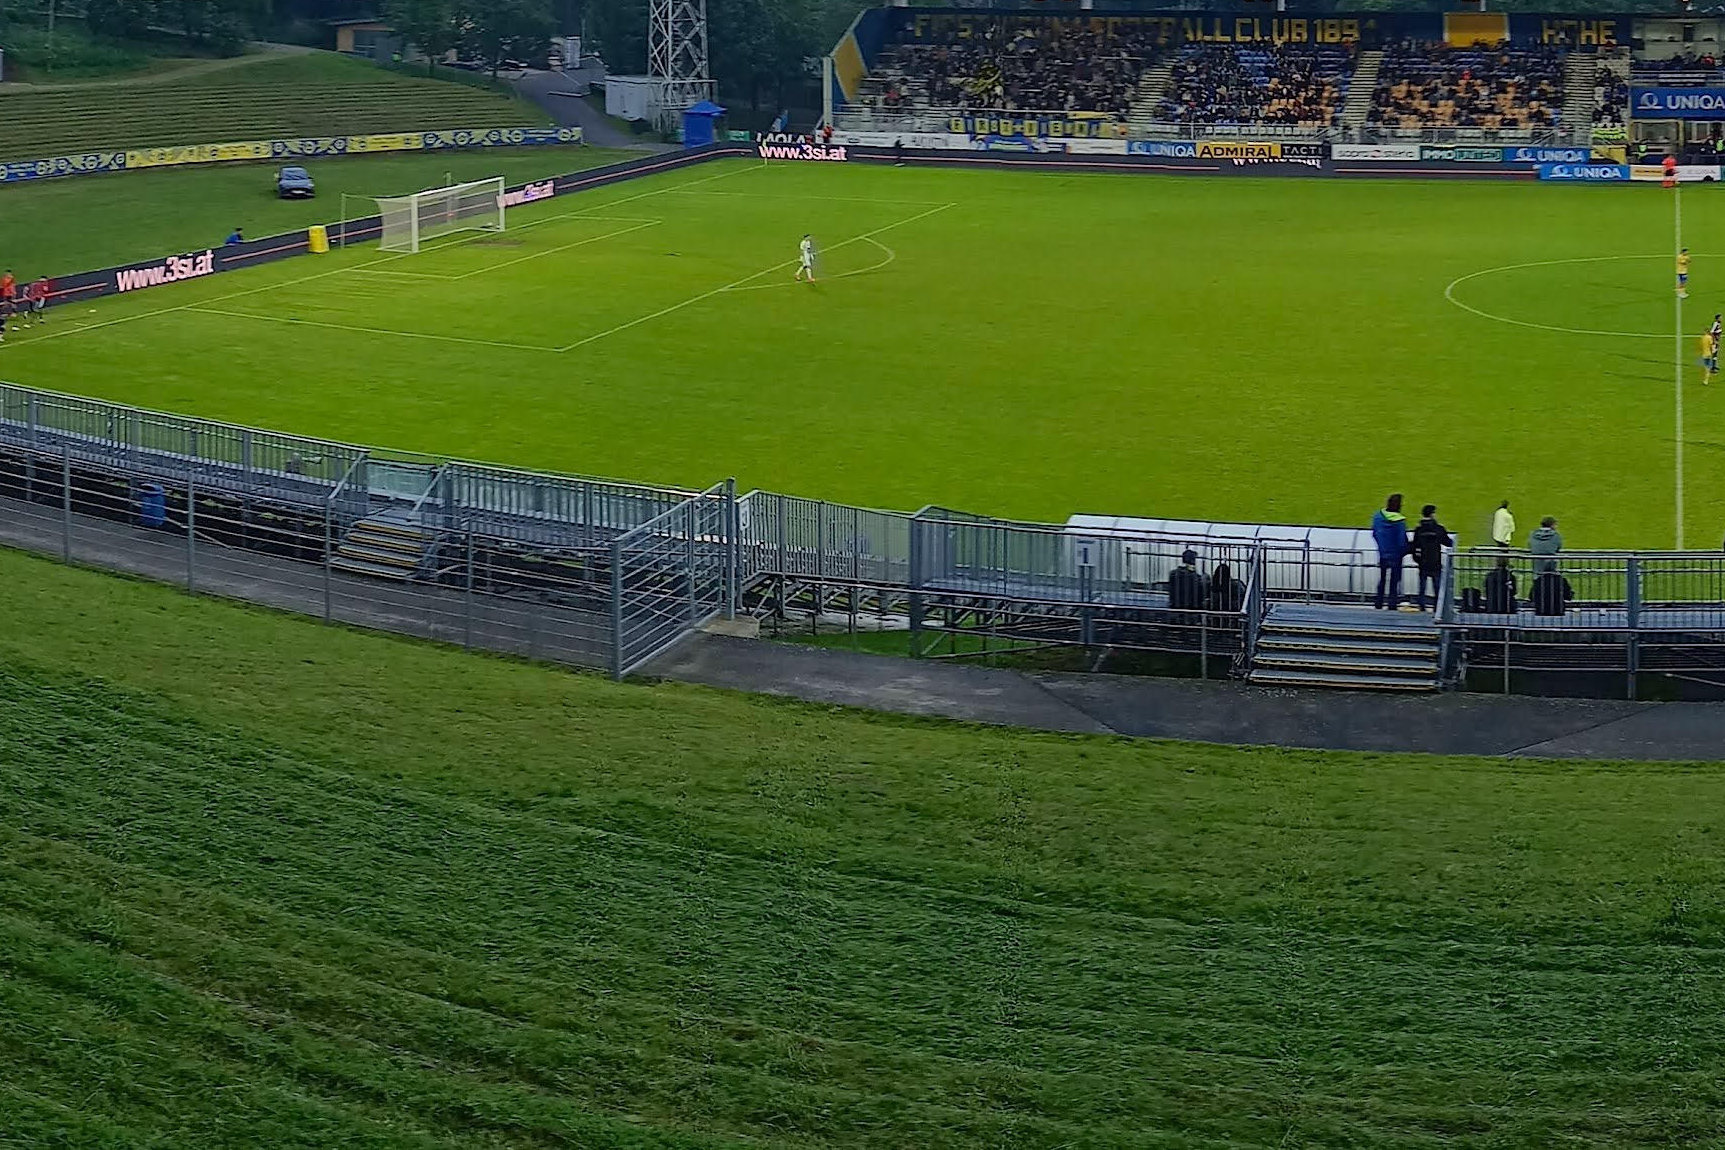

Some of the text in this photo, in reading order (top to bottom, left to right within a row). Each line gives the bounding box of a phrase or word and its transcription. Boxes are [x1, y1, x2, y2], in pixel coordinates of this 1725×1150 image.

[1235, 18, 1308, 43] CLUB
[759, 144, 847, 161] www.3si.at
[1149, 144, 1196, 159] UNIQA
[1200, 144, 1279, 159] ADMIRAL
[1282, 145, 1323, 156] TACTI
[1537, 150, 1585, 163] UNIQA
[1574, 166, 1623, 179] UNIQA
[116, 249, 215, 292] www.3si.at
